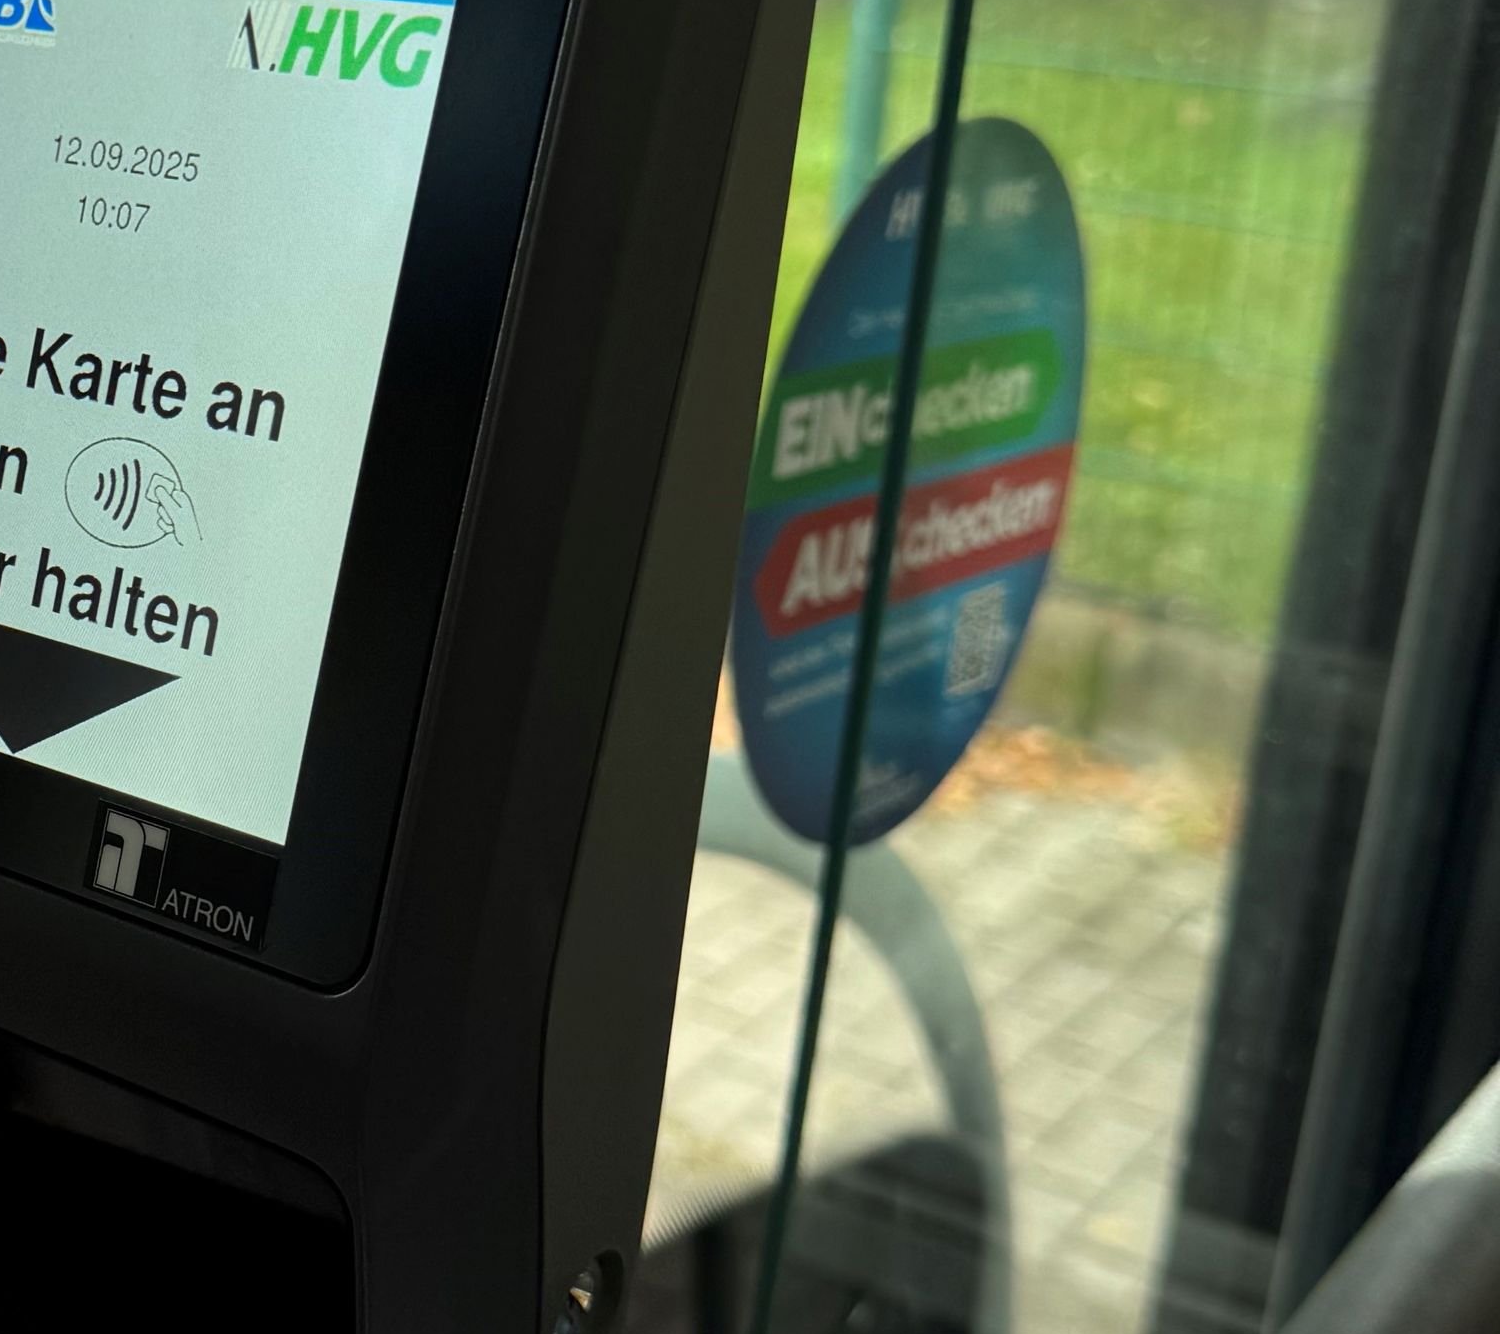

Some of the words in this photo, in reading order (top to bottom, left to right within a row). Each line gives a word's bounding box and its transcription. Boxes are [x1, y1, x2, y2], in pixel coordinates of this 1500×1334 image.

[52, 134, 201, 183] 12.09.2025
[77, 195, 151, 234] 10:07
[25, 328, 188, 420] Karte
[206, 380, 286, 442] an
[771, 361, 1038, 480] EINcecken
[30, 547, 220, 657] halten
[161, 887, 255, 942] ATRON
